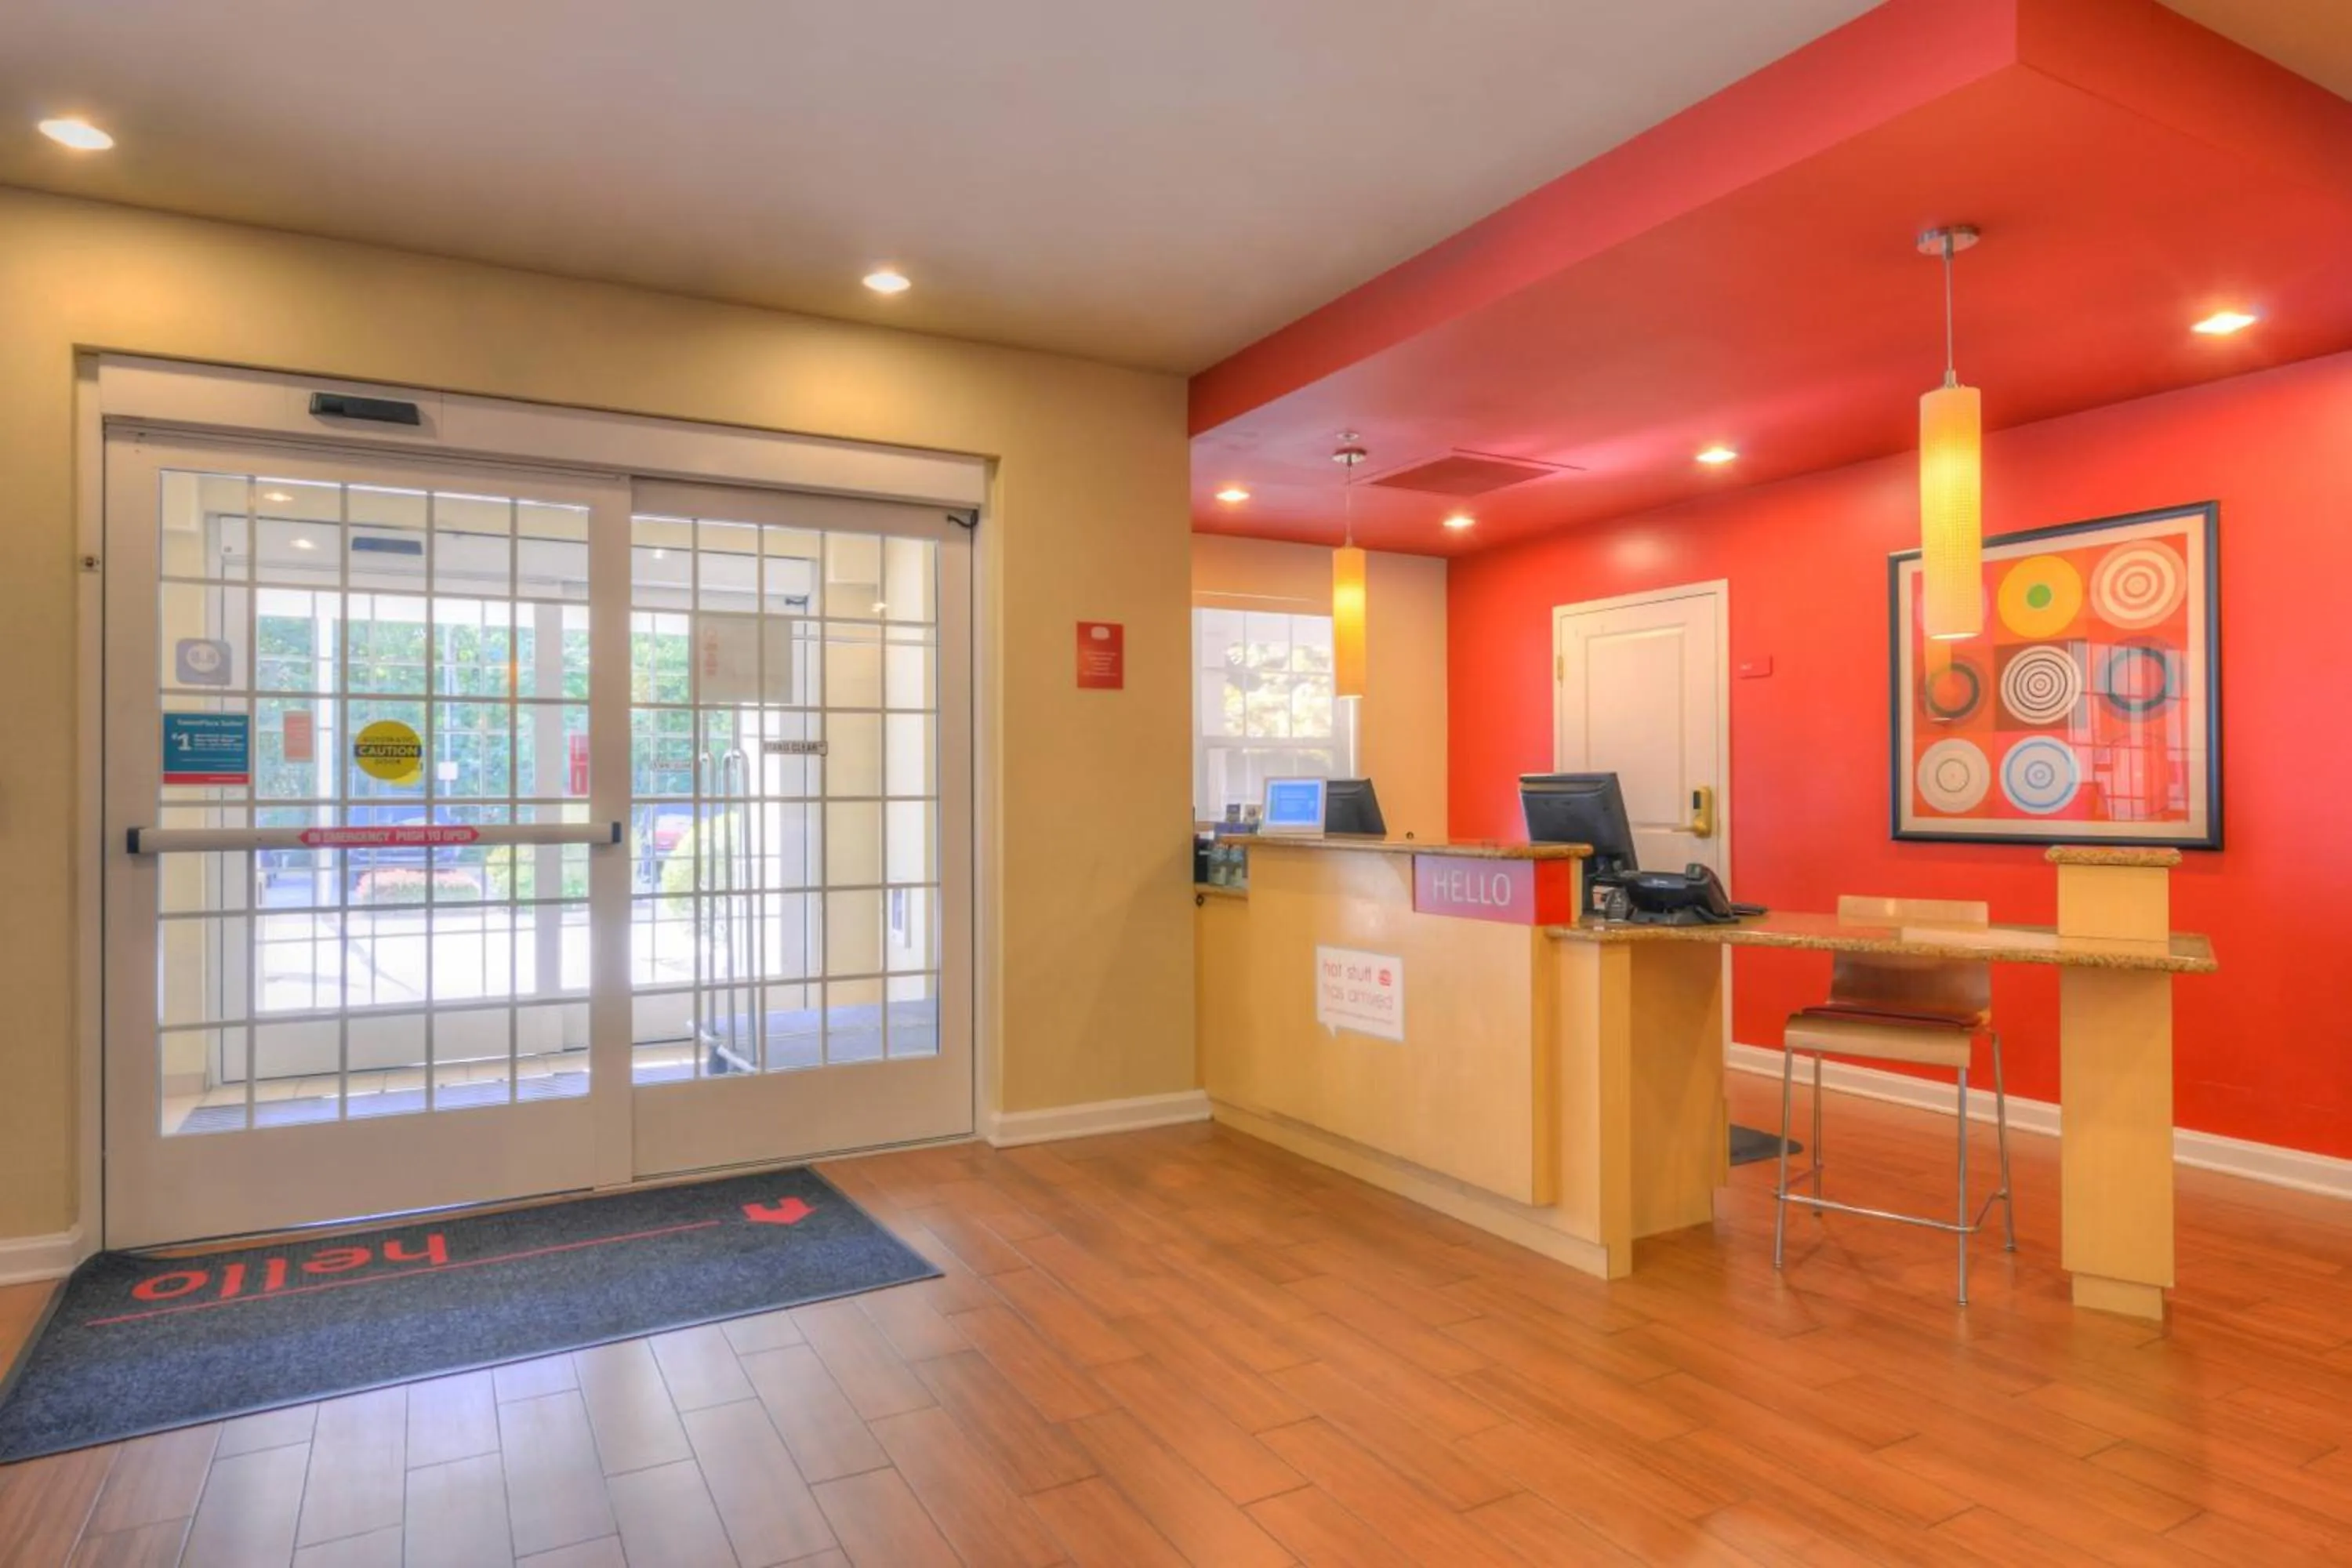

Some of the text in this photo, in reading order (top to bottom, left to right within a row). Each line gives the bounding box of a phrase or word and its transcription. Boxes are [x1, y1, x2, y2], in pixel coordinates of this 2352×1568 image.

[358, 746, 419, 756] CAUTION
[323, 831, 390, 843] EMERGENCY
[396, 829, 425, 841] PUSH
[427, 829, 441, 840] TO
[443, 829, 472, 840] OPEN
[1432, 869, 1512, 906] HELLO
[1323, 959, 1341, 978] hot
[131, 1234, 448, 1299] hello
